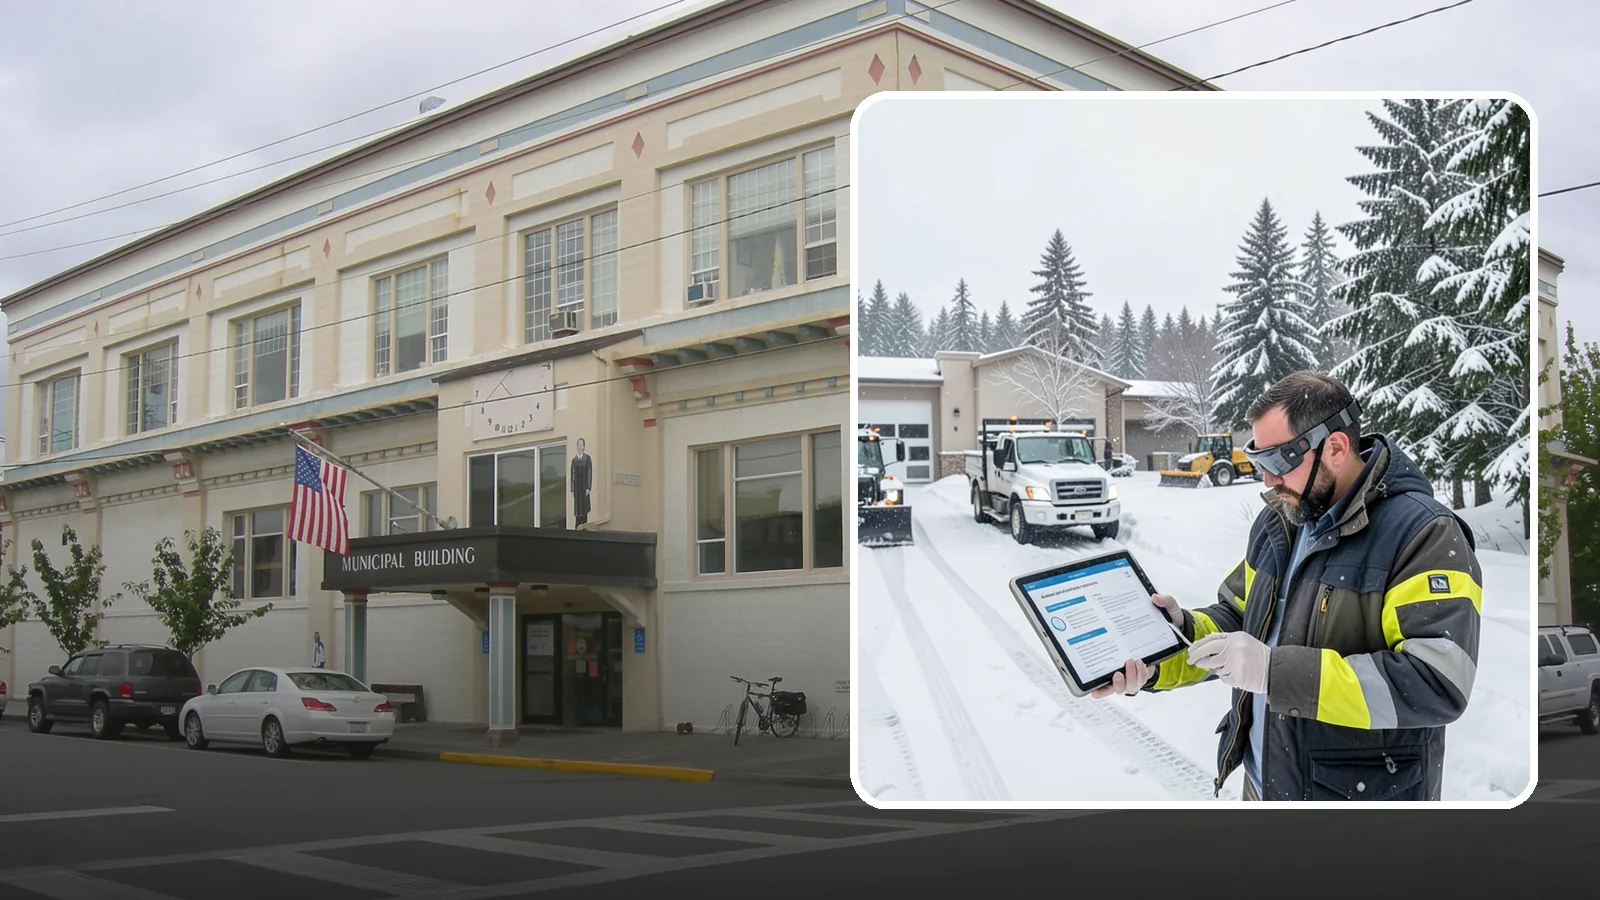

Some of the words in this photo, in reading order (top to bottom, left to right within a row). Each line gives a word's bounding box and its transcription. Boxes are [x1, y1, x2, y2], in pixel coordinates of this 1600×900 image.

[547, 361, 552, 370] 6
[536, 402, 540, 410] 4
[480, 407, 484, 415] 8
[488, 418, 492, 426] 9
[529, 414, 533, 422] 3
[521, 420, 526, 428] 2
[342, 552, 404, 571] MUNICIPAL
[414, 547, 475, 567] BUILDING
